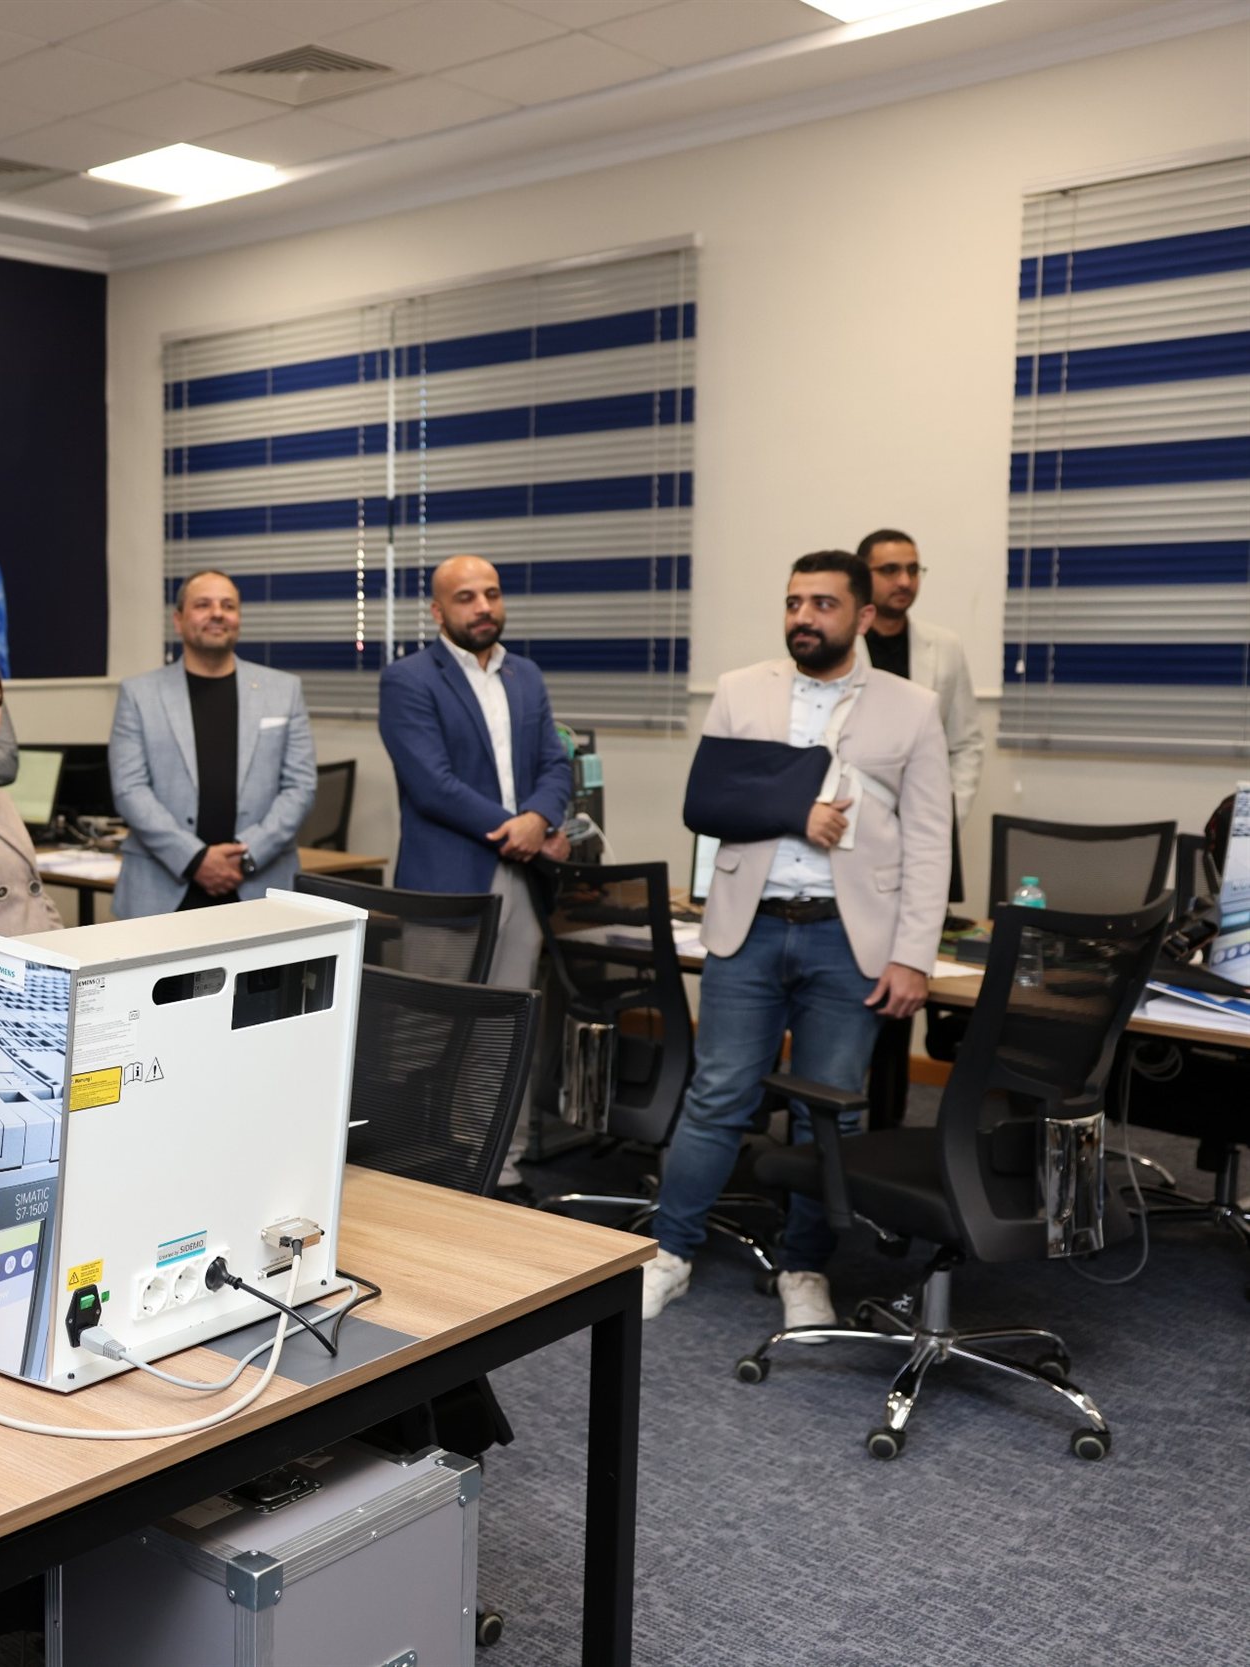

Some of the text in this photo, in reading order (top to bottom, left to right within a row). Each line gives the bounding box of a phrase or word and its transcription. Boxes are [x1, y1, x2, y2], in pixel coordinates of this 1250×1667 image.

[76, 979, 96, 987] IEMENS
[15, 1187, 50, 1207] SIMATIC
[15, 1201, 49, 1221] S7-1500
